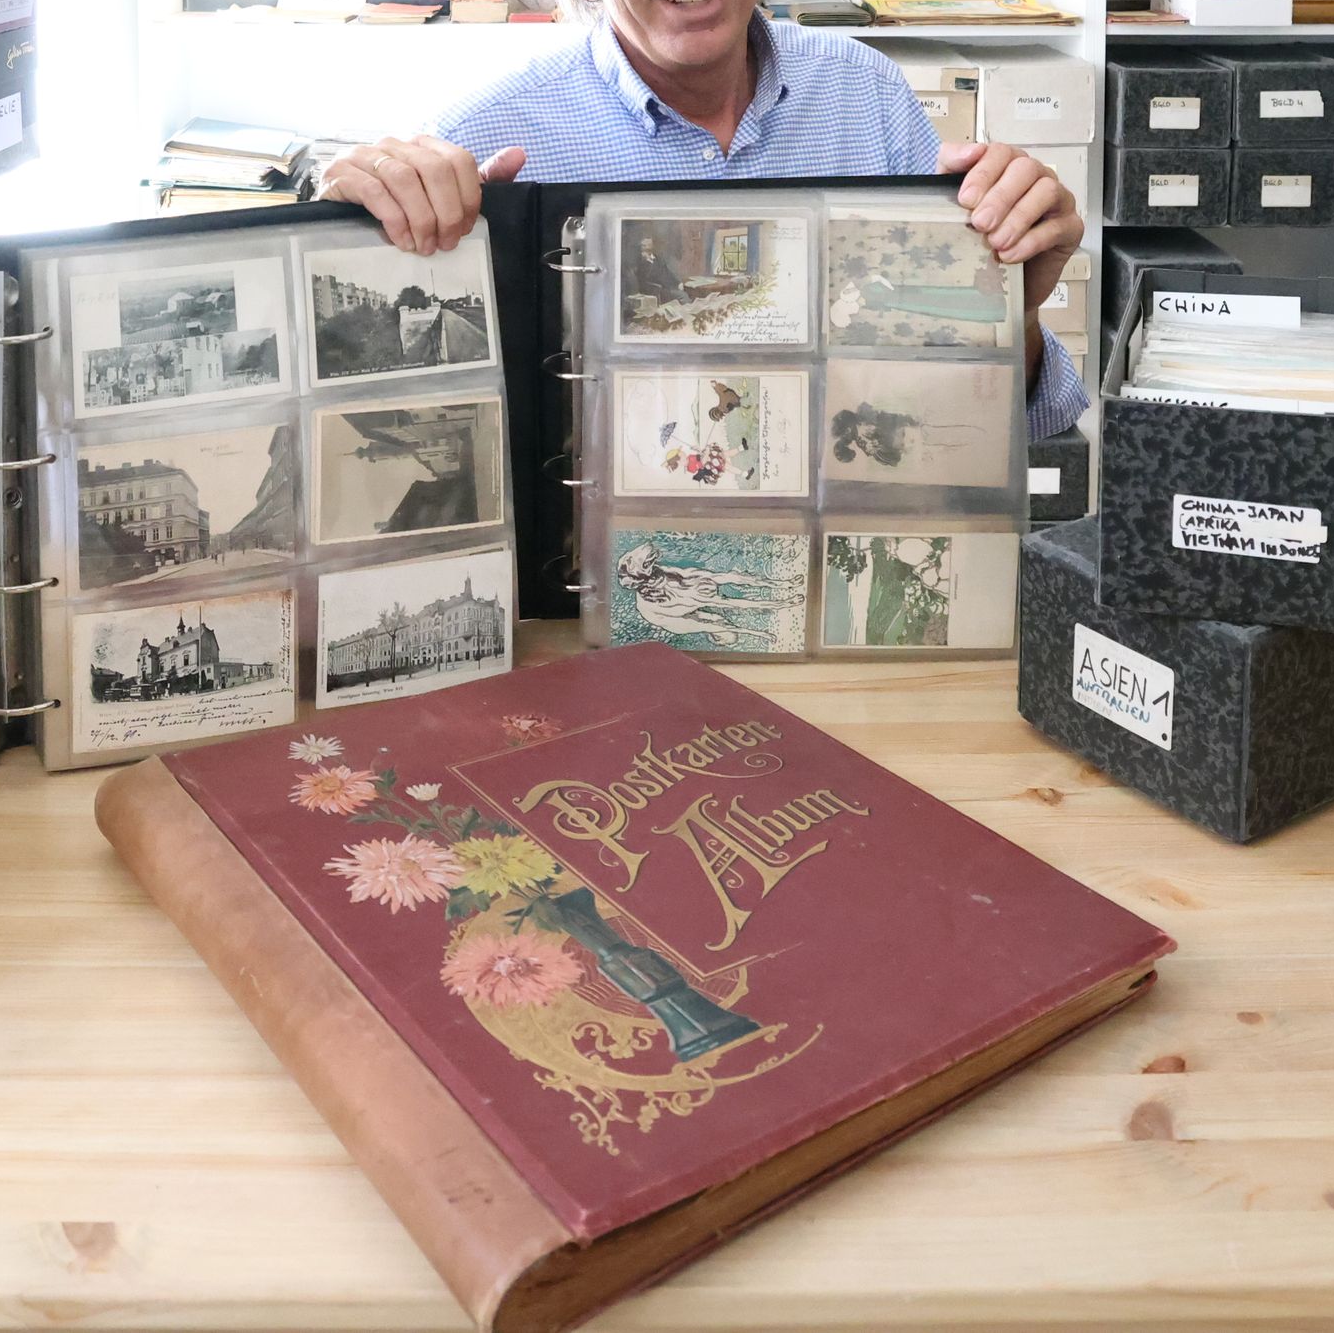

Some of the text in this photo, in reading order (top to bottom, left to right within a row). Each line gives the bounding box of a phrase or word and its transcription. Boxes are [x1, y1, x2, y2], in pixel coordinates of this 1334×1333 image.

[1017, 96, 1059, 110] AUSLAND 6
[1152, 100, 1171, 108] BGLD
[1270, 98, 1294, 108] BGLD
[1059, 293, 1066, 302] 2
[1185, 515, 1241, 533] AFRIKA
[1080, 647, 1170, 717] ASIEN 1
